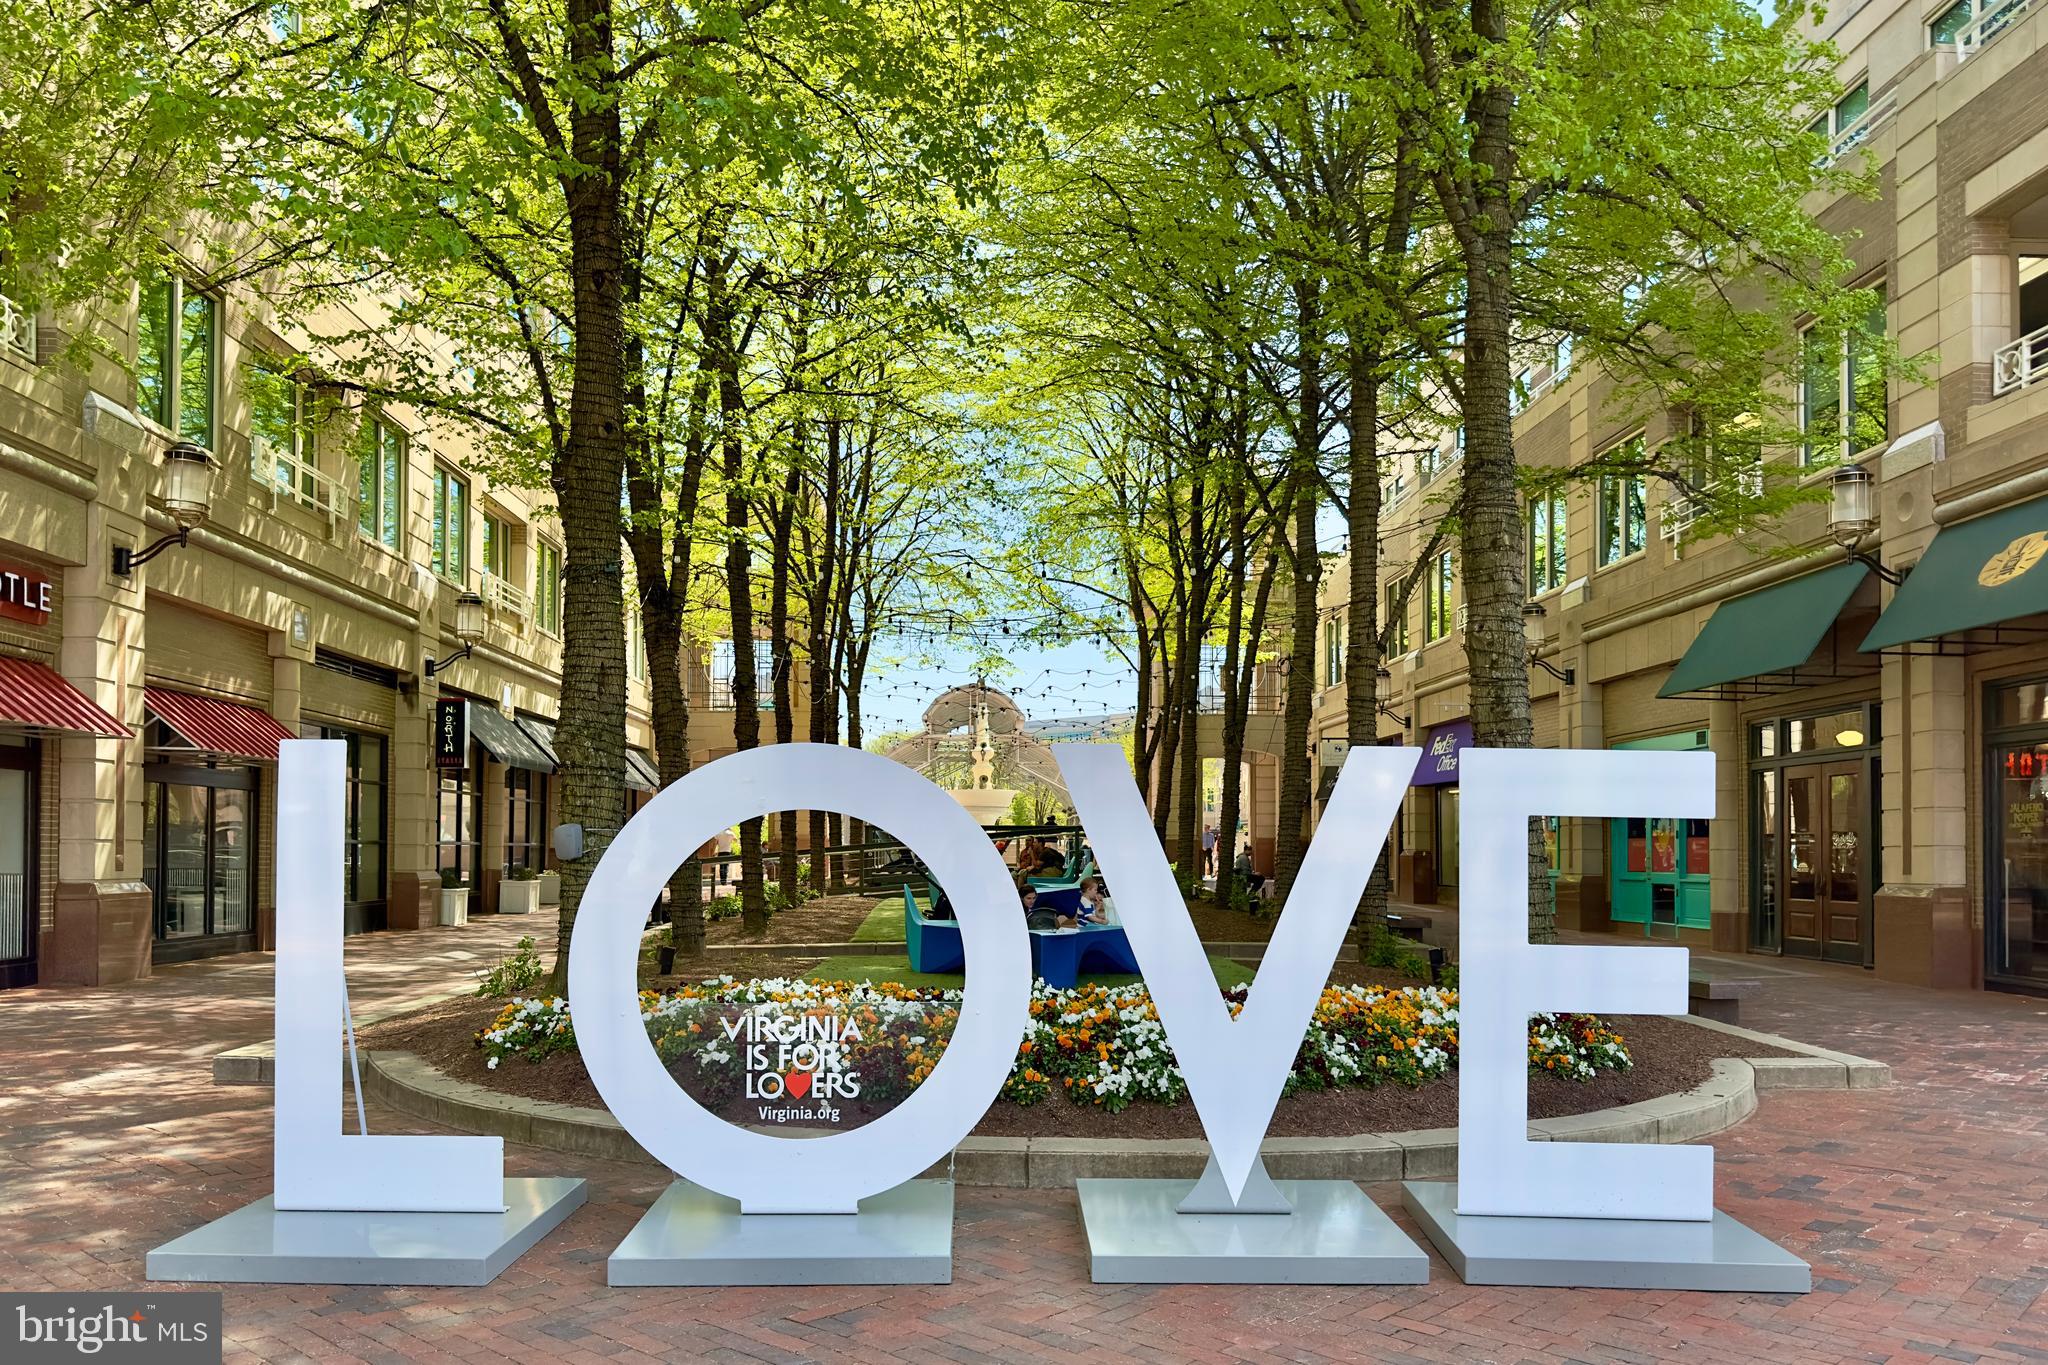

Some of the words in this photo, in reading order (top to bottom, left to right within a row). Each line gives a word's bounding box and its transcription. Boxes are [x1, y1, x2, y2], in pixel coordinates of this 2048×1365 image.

[0, 572, 52, 612] TLE
[444, 706, 454, 753] NORTH
[1430, 733, 1457, 756] FedEx
[1436, 755, 1458, 772] Office
[274, 740, 1717, 1222] LOVE
[720, 1015, 863, 1043] VIRGINIA
[746, 1044, 769, 1071] IS
[778, 1043, 842, 1071] FOR
[758, 1106, 840, 1122] Virginia.org
